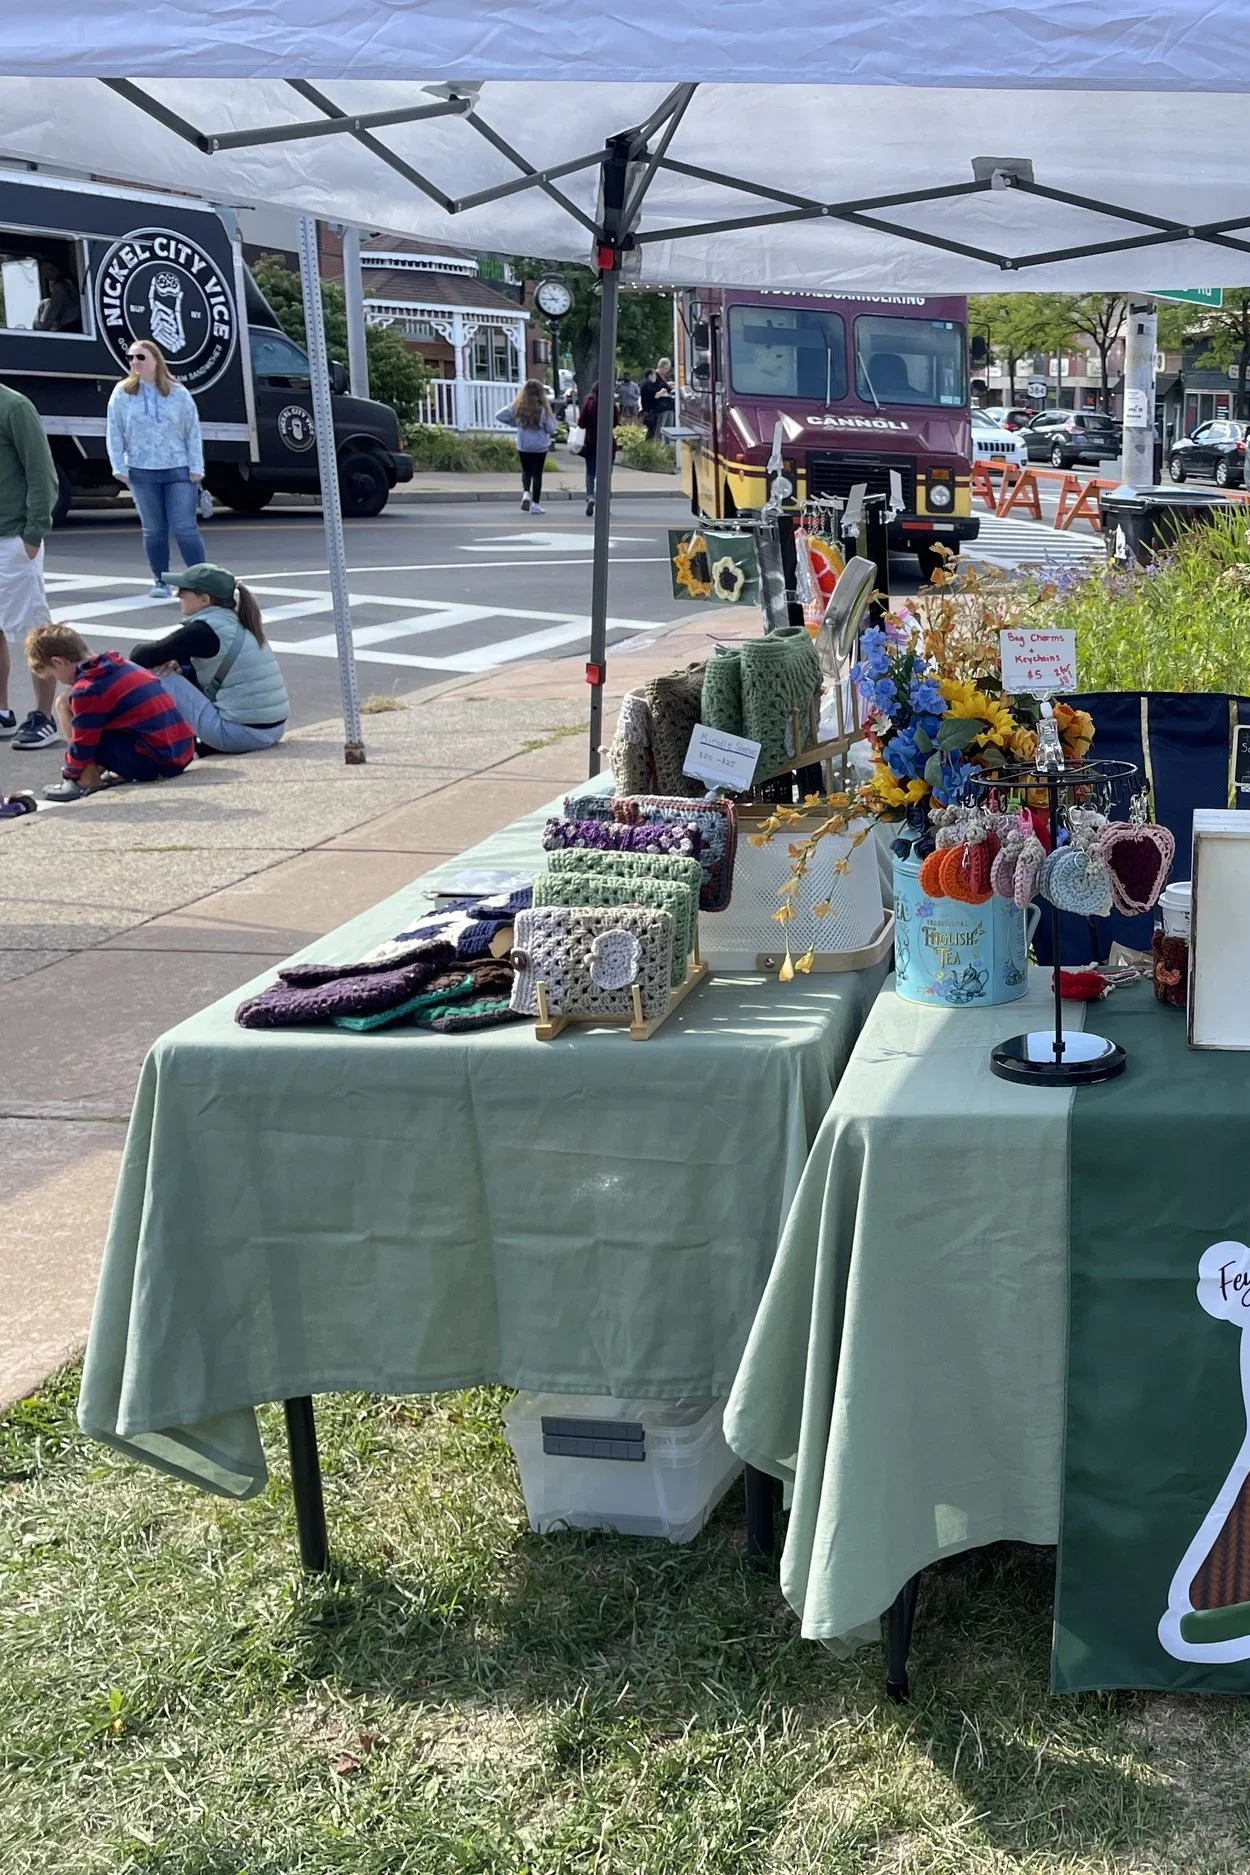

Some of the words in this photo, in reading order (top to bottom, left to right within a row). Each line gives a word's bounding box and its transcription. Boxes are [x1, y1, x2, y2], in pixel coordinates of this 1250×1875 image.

[103, 242, 151, 327] NICKEL
[153, 237, 207, 275] CITY
[204, 275, 230, 340] VICE
[1029, 386, 1045, 395] 384
[806, 415, 910, 431] CANNOLI
[1007, 632, 1025, 648] Bag
[1030, 633, 1064, 642] Charms
[1014, 654, 1060, 664] Keychains
[1027, 669, 1042, 680] $5
[701, 732, 733, 750] Kindle
[922, 926, 975, 947] ENGLISH
[934, 946, 962, 968] TEA
